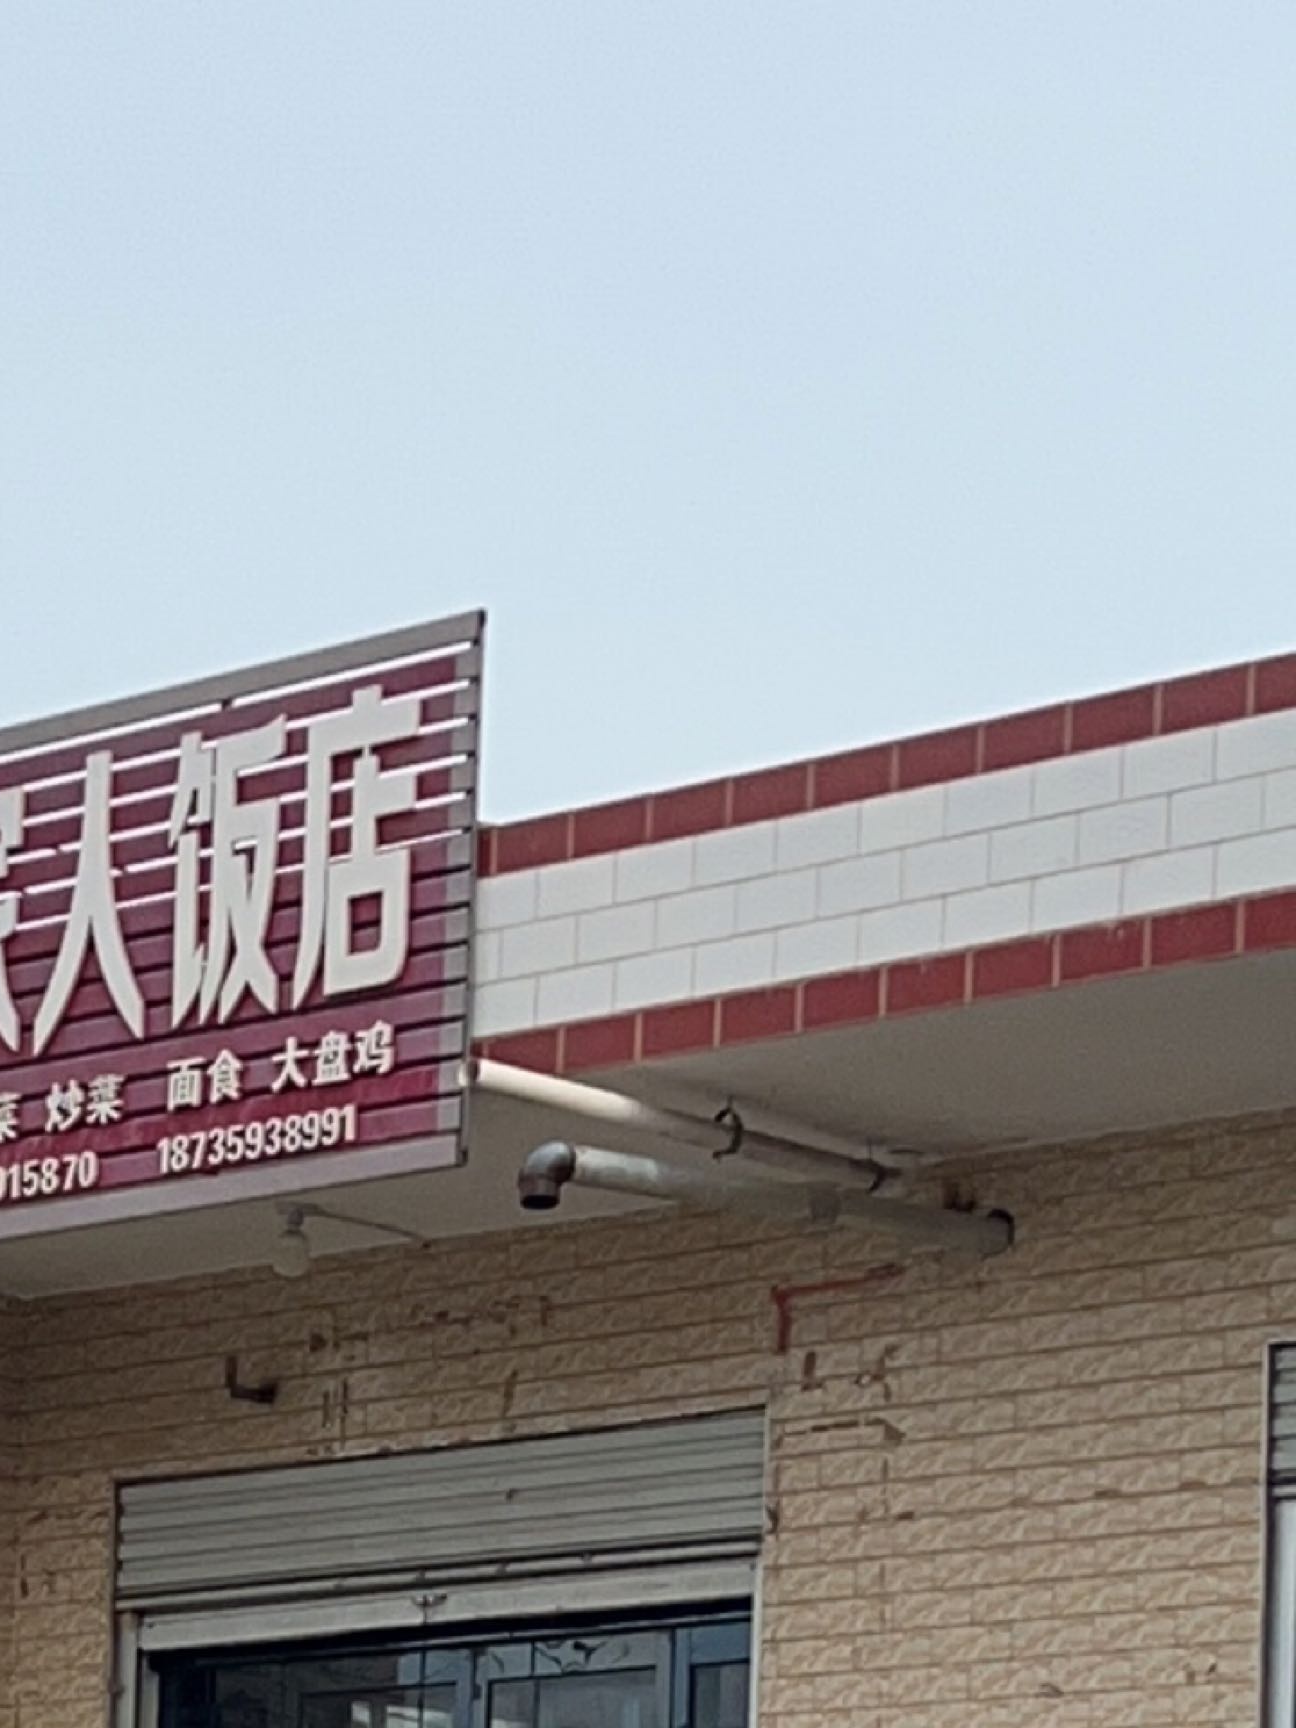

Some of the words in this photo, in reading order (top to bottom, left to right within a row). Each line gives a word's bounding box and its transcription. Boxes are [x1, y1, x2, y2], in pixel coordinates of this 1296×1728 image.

[44, 1073, 127, 1132] 炒菜
[166, 1048, 243, 1111] 面食
[271, 1019, 396, 1093] 大盘鸡
[156, 1103, 358, 1174] 18735938991
